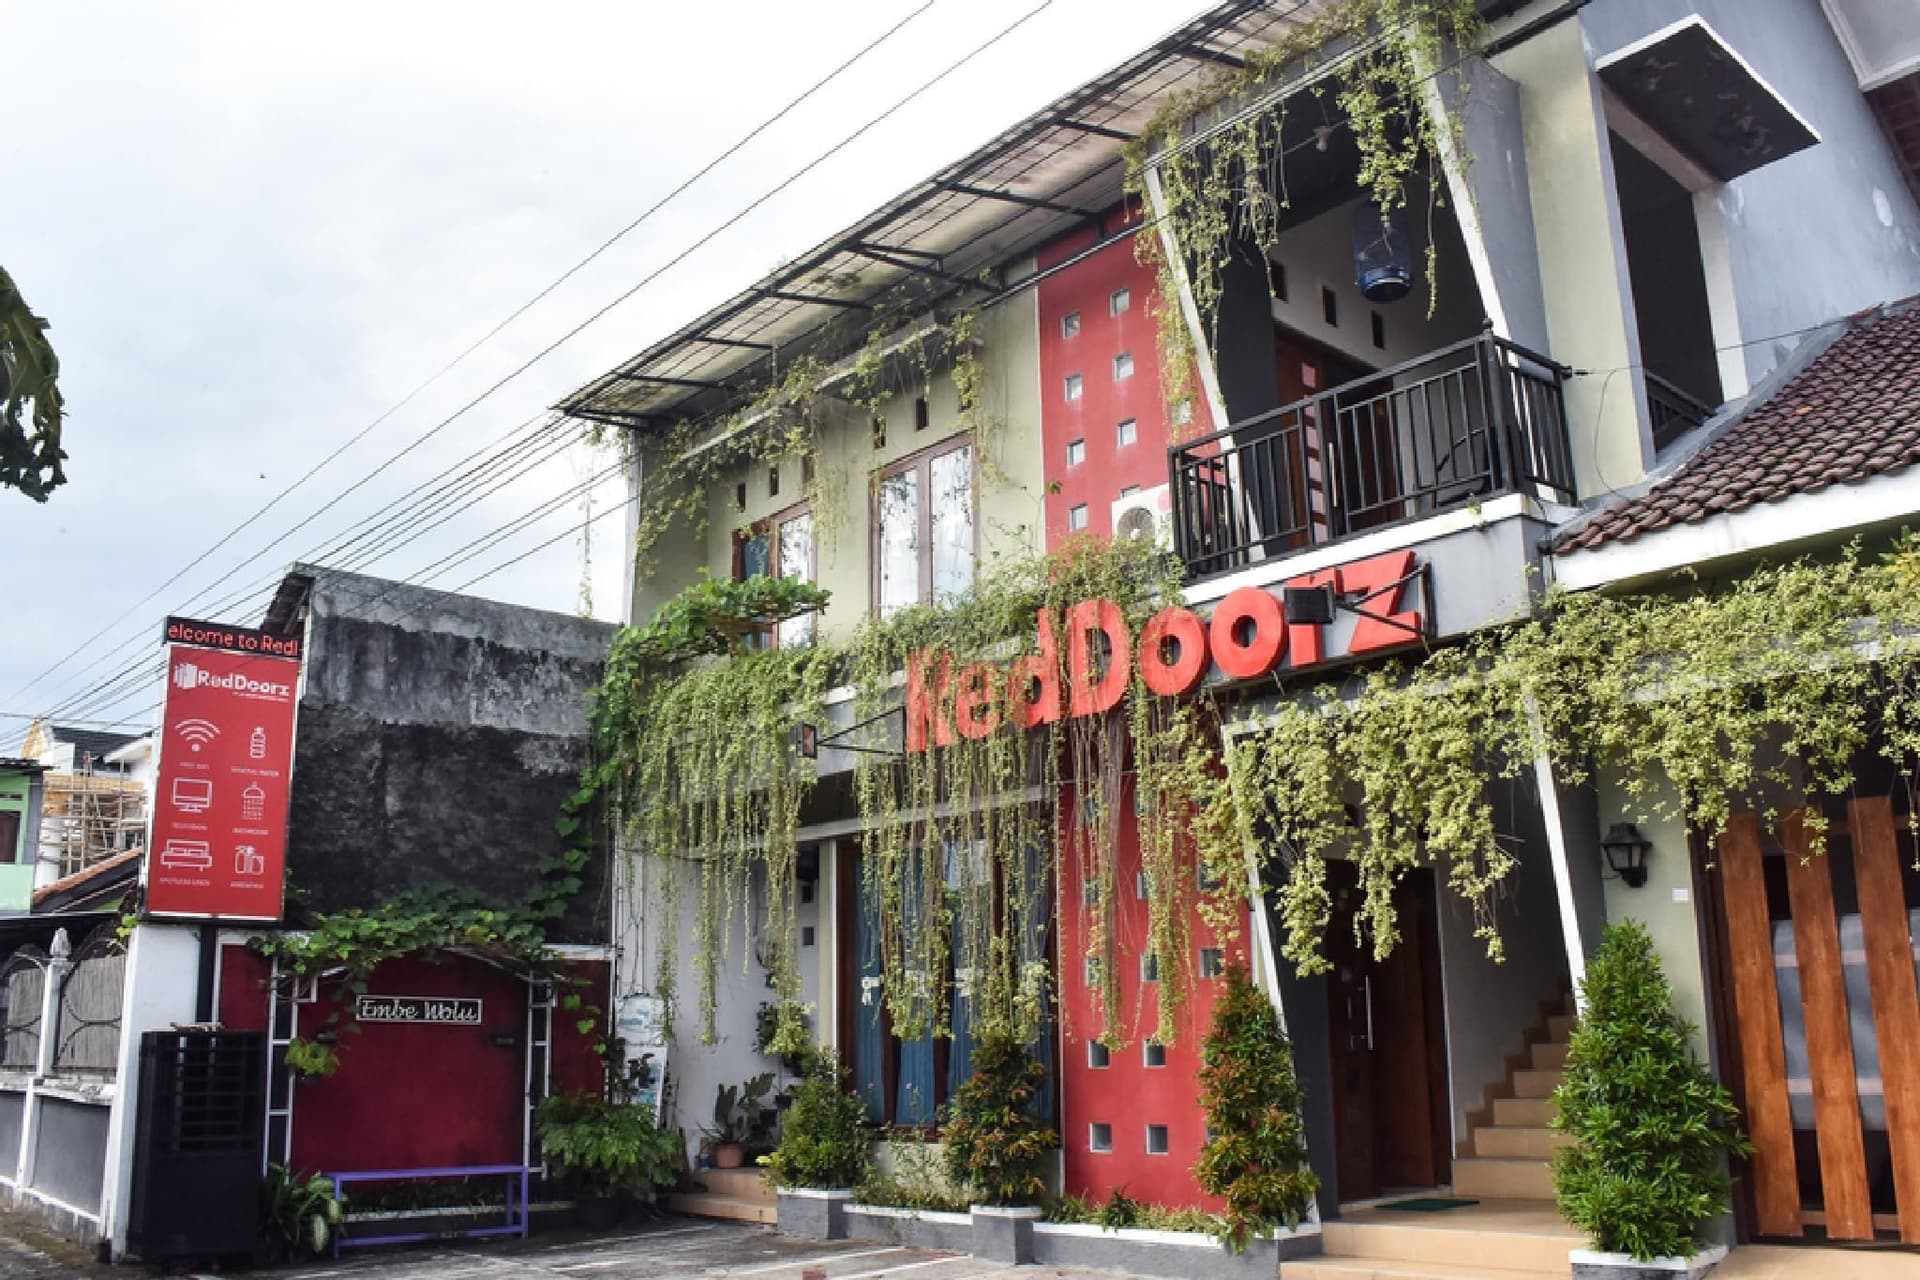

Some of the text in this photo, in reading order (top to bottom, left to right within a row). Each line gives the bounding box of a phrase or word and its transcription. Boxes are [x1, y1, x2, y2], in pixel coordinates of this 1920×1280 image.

[238, 634, 257, 650] to
[198, 670, 290, 696] RedDoorz
[362, 999, 419, 1019] Embe
